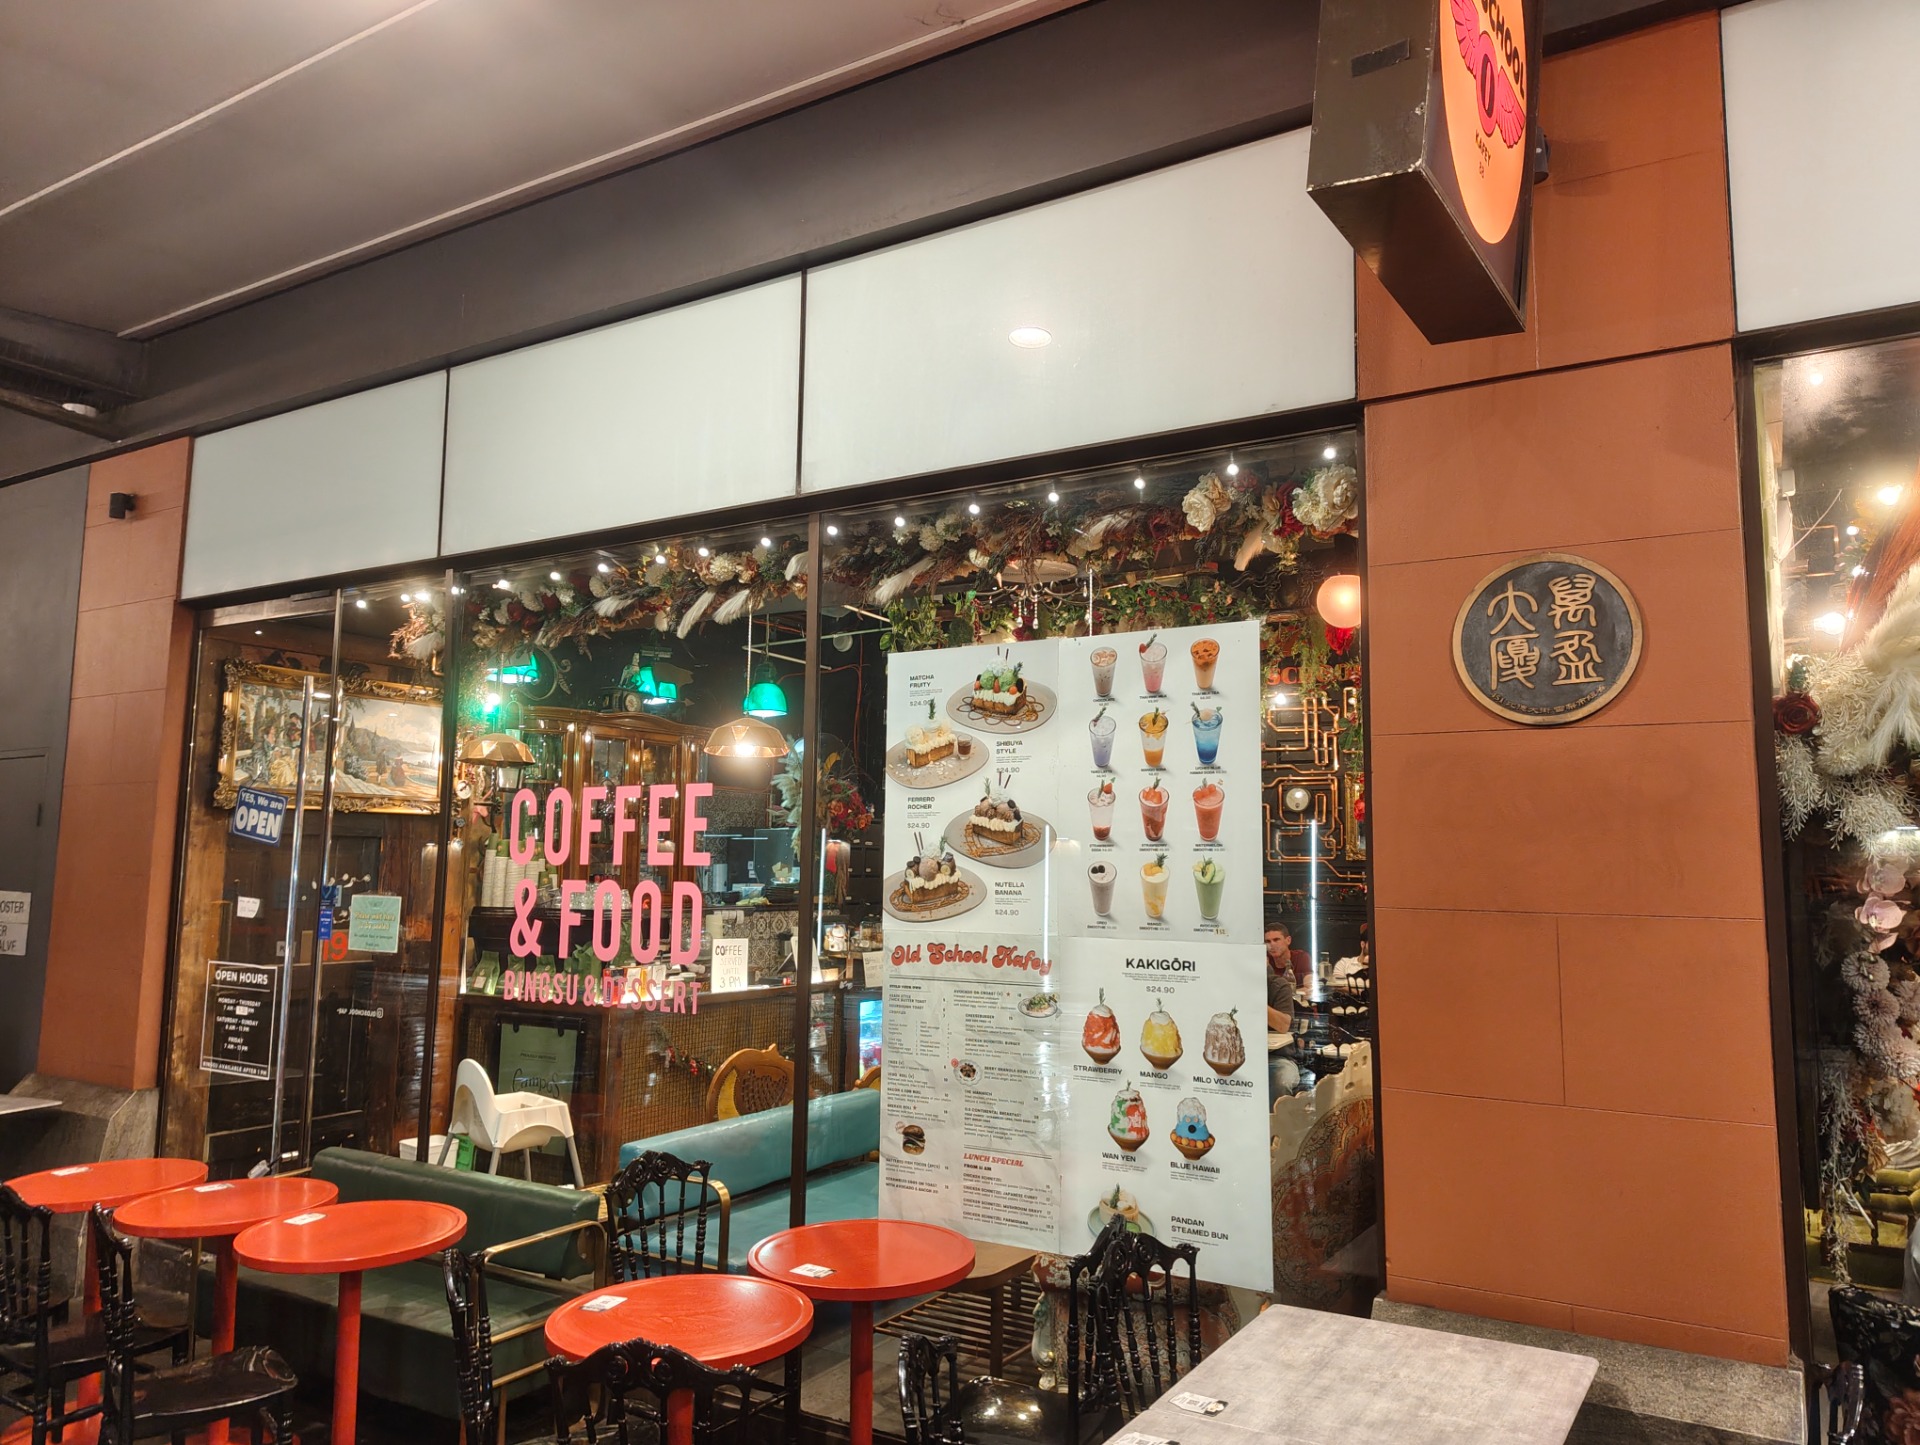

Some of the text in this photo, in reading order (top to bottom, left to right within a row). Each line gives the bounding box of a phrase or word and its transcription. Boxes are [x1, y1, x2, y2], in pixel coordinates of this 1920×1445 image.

[909, 674, 935, 682] MATCHA
[996, 766, 1020, 774] $24.90
[241, 792, 283, 810] YES, We are
[235, 805, 283, 838] OPEN
[509, 782, 714, 866] COFFEE
[994, 881, 1025, 889] NUTELLA
[0, 901, 24, 914] OSTER
[509, 878, 703, 966] & FOOD
[715, 944, 742, 956] COFFEE
[720, 956, 743, 966] SERVED
[891, 942, 1053, 977] Old School Kafey
[1126, 957, 1196, 972] KAKIGŌRI
[215, 970, 269, 985] OPEN HOURS
[720, 975, 742, 989] 3 PM
[503, 969, 702, 1015] BINGSU & DESSERT
[1146, 985, 1175, 994] $24.90
[228, 1036, 243, 1044] FRIDAY
[1073, 1064, 1123, 1075] STRAWBERRY
[1139, 1071, 1168, 1080] MANGO
[512, 1067, 560, 1099] Campos
[1192, 1076, 1254, 1088] MILO VOLCANO
[963, 1153, 1025, 1168] LUNCH SPECIAL
[1102, 1152, 1137, 1163] WAN YEN
[1170, 1161, 1191, 1171] BLUE
[1170, 1215, 1205, 1227] PANDAN
[1171, 1225, 1229, 1240] STEAMED BUN
